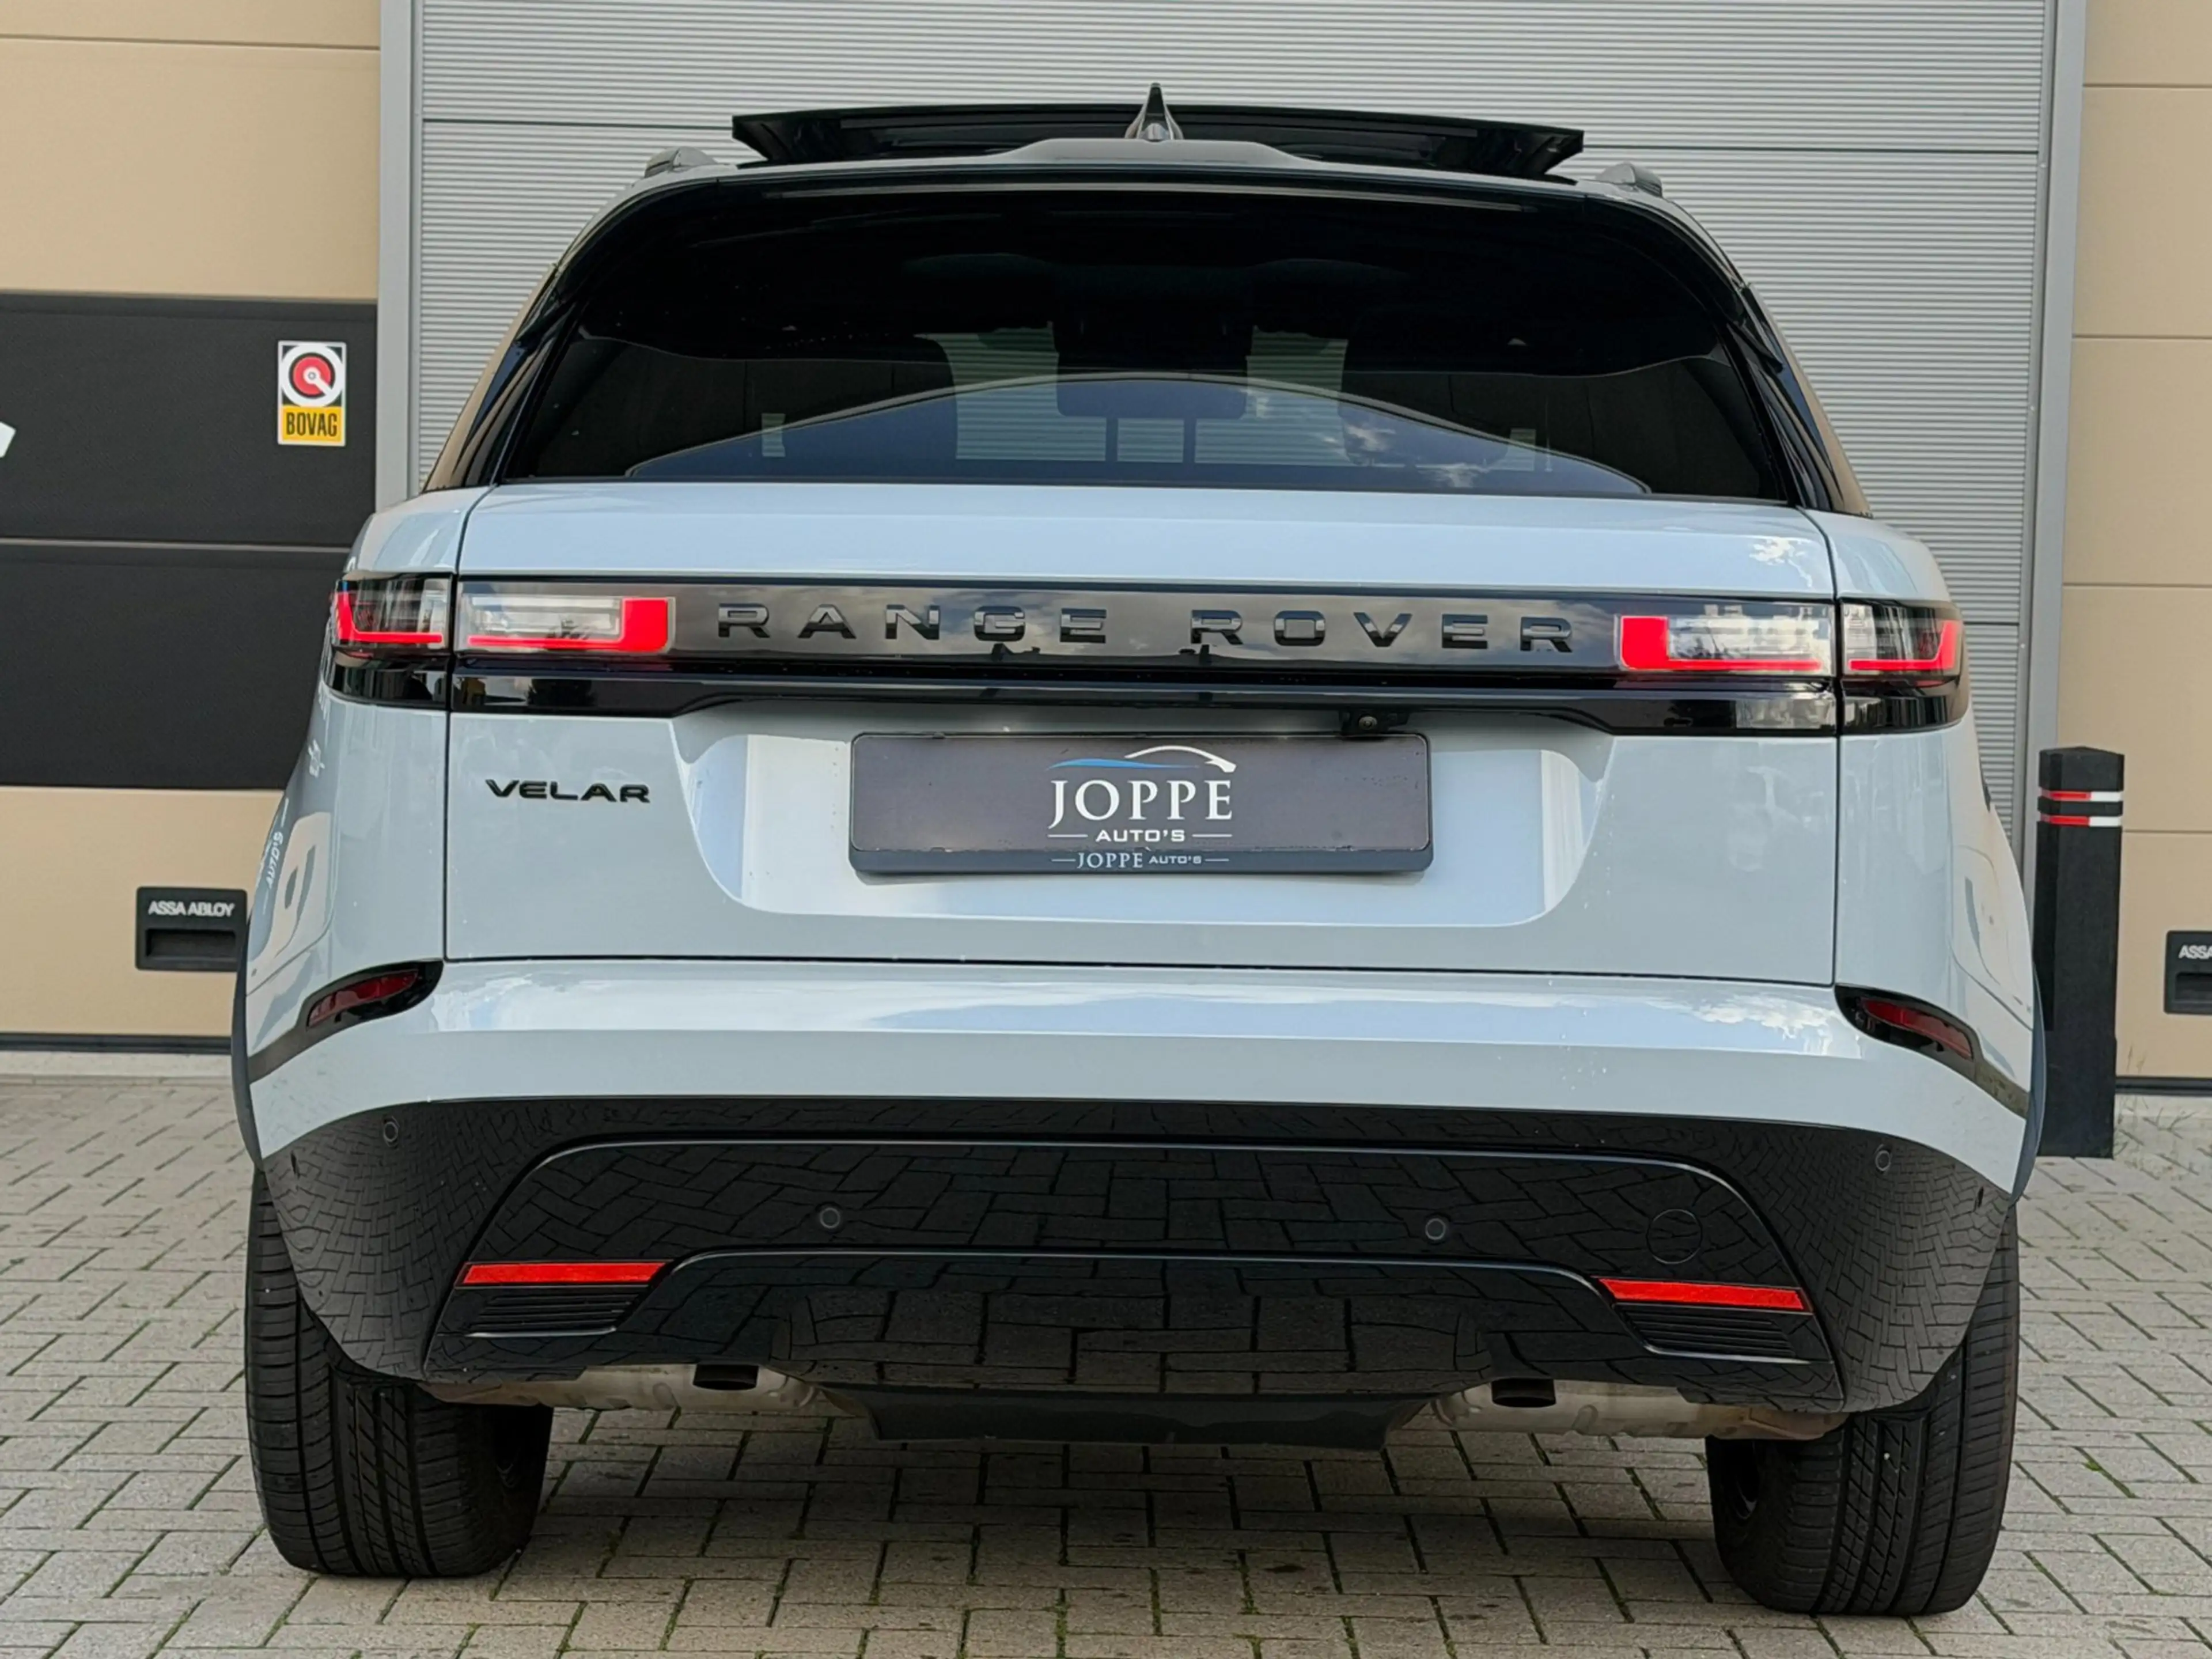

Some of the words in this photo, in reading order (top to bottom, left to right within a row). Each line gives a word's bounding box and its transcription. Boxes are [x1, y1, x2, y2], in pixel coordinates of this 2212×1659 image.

[286, 412, 338, 437] BOVAG
[718, 603, 1107, 644] RANGE
[1190, 609, 1573, 653] ROVER
[485, 779, 650, 804] VELAR
[1048, 779, 1233, 830] JOPPE
[1095, 830, 1185, 843] AUTO'S
[1077, 852, 1143, 869] JOPPE
[1149, 855, 1202, 865] AUTO'S
[148, 900, 186, 915] ASSA
[187, 902, 235, 916] ABLOY
